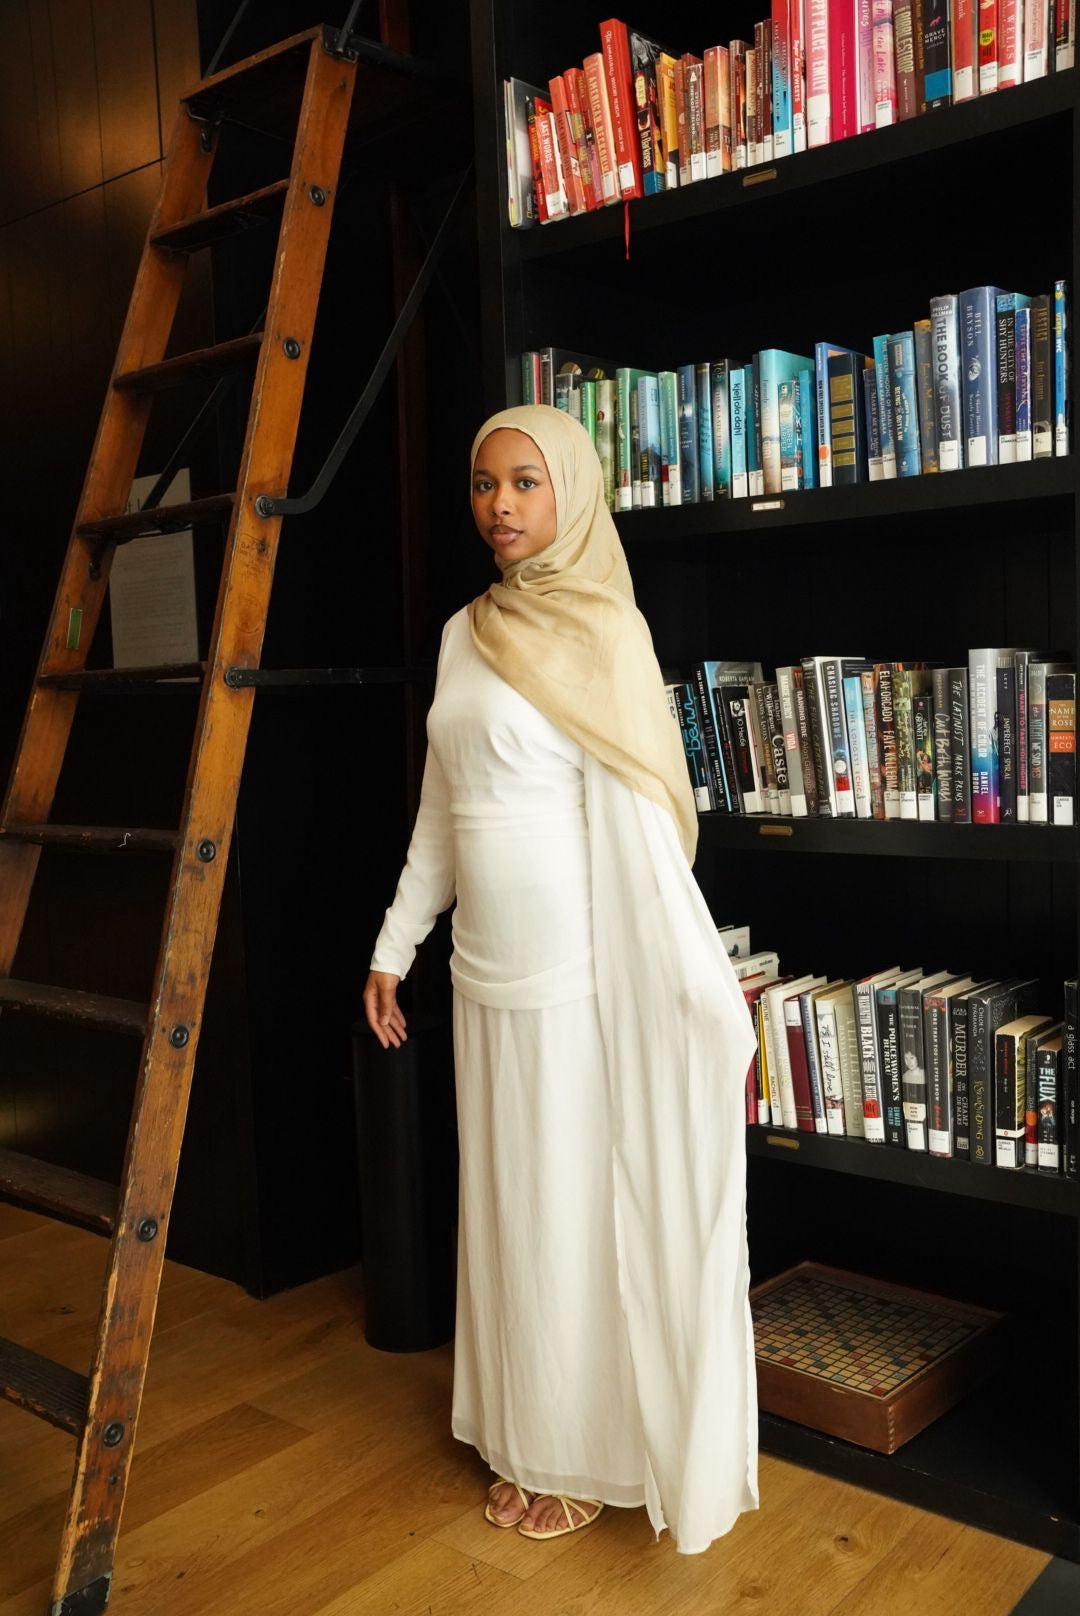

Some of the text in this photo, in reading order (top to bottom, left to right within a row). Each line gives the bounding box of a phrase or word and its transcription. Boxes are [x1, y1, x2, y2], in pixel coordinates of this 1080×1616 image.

[925, 28, 944, 39] GRAVE
[925, 33, 946, 44] MERCY
[1006, 15, 1015, 59] WELLS
[812, 20, 826, 91] PLACE EMILY
[877, 51, 886, 74] Lake
[588, 76, 603, 122] AMERICAN
[541, 120, 552, 163] LAST WORDS
[641, 130, 652, 168] In Darkness
[966, 305, 975, 347] BRYSON
[974, 312, 982, 336] BILL
[1007, 317, 1013, 327] IN
[999, 319, 1008, 383] SHY HUNTERS
[936, 318, 952, 439] THE BOOK OF DUST
[1008, 371, 1015, 382] OF
[732, 384, 741, 401] kjell
[886, 399, 891, 407] OF
[733, 416, 743, 436] dahl
[774, 700, 782, 721] Isabel
[783, 698, 792, 719] PIERCY
[826, 665, 841, 739] CHASING SHADOWS
[976, 664, 988, 758] THE ACCIDENT OF COLOR
[1050, 707, 1075, 715] NAME
[797, 691, 805, 721] RAINING
[802, 741, 810, 759] Alan
[879, 670, 898, 792] EL AHORCADO FAYE KELLERMA
[915, 713, 923, 740] BENNETT
[1019, 716, 1025, 727] TO
[766, 693, 788, 784] Wilkerson Caste
[787, 733, 796, 750] VIDA
[851, 728, 859, 766] LONGEST
[952, 680, 964, 802] THE LATINIST MARK PRINS
[1003, 718, 1011, 755] IMPERFECT
[1031, 742, 1041, 752] WE
[1054, 741, 1073, 749] ECO
[934, 713, 952, 802] Cut Both Ways
[1032, 752, 1041, 767] SAID
[972, 772, 980, 794] BROOK
[980, 771, 988, 795] DANIEL
[1032, 766, 1041, 778] YES
[847, 1030, 860, 1077] LITTLE
[860, 1026, 875, 1059] BLACK
[954, 1023, 966, 1077] MURDER
[1066, 1033, 1077, 1054] glass
[822, 1050, 834, 1071] still
[882, 1038, 891, 1076] BUREAU
[889, 1027, 900, 1101] POLICEWOMEN'S
[1067, 1056, 1076, 1070] act
[825, 1072, 835, 1094] love
[1039, 1067, 1055, 1076] THE
[852, 1081, 862, 1109] LIFE
[956, 1096, 962, 1107] DE
[1039, 1076, 1056, 1103] FLUX
